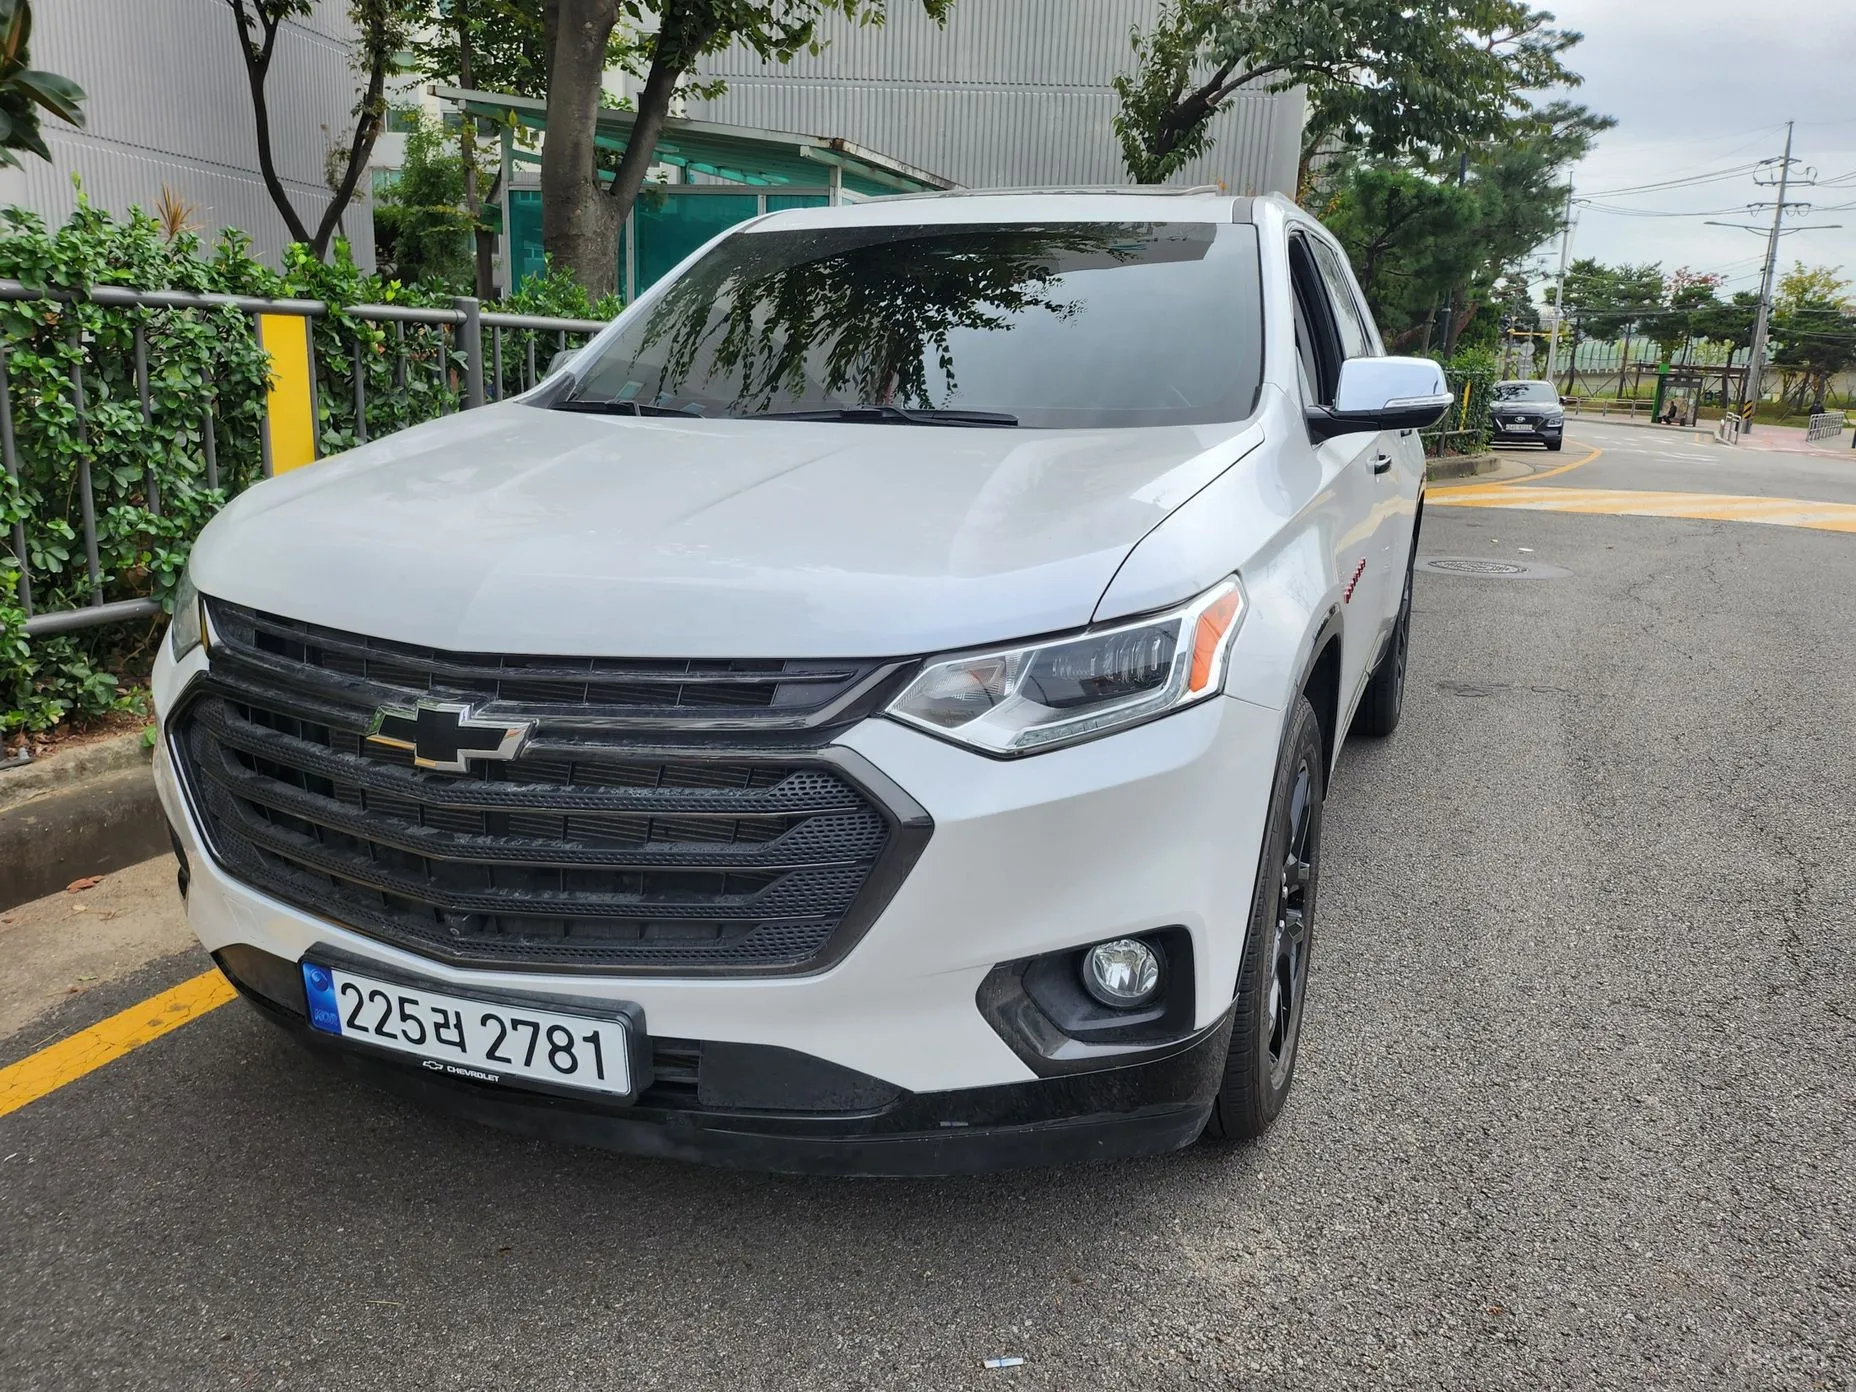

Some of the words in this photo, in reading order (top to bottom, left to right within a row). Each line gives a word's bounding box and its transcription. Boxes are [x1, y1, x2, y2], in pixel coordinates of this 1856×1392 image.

[341, 982, 468, 1053] 225러
[480, 1013, 605, 1080] 2781
[447, 1066, 500, 1082] CHEVROLET
